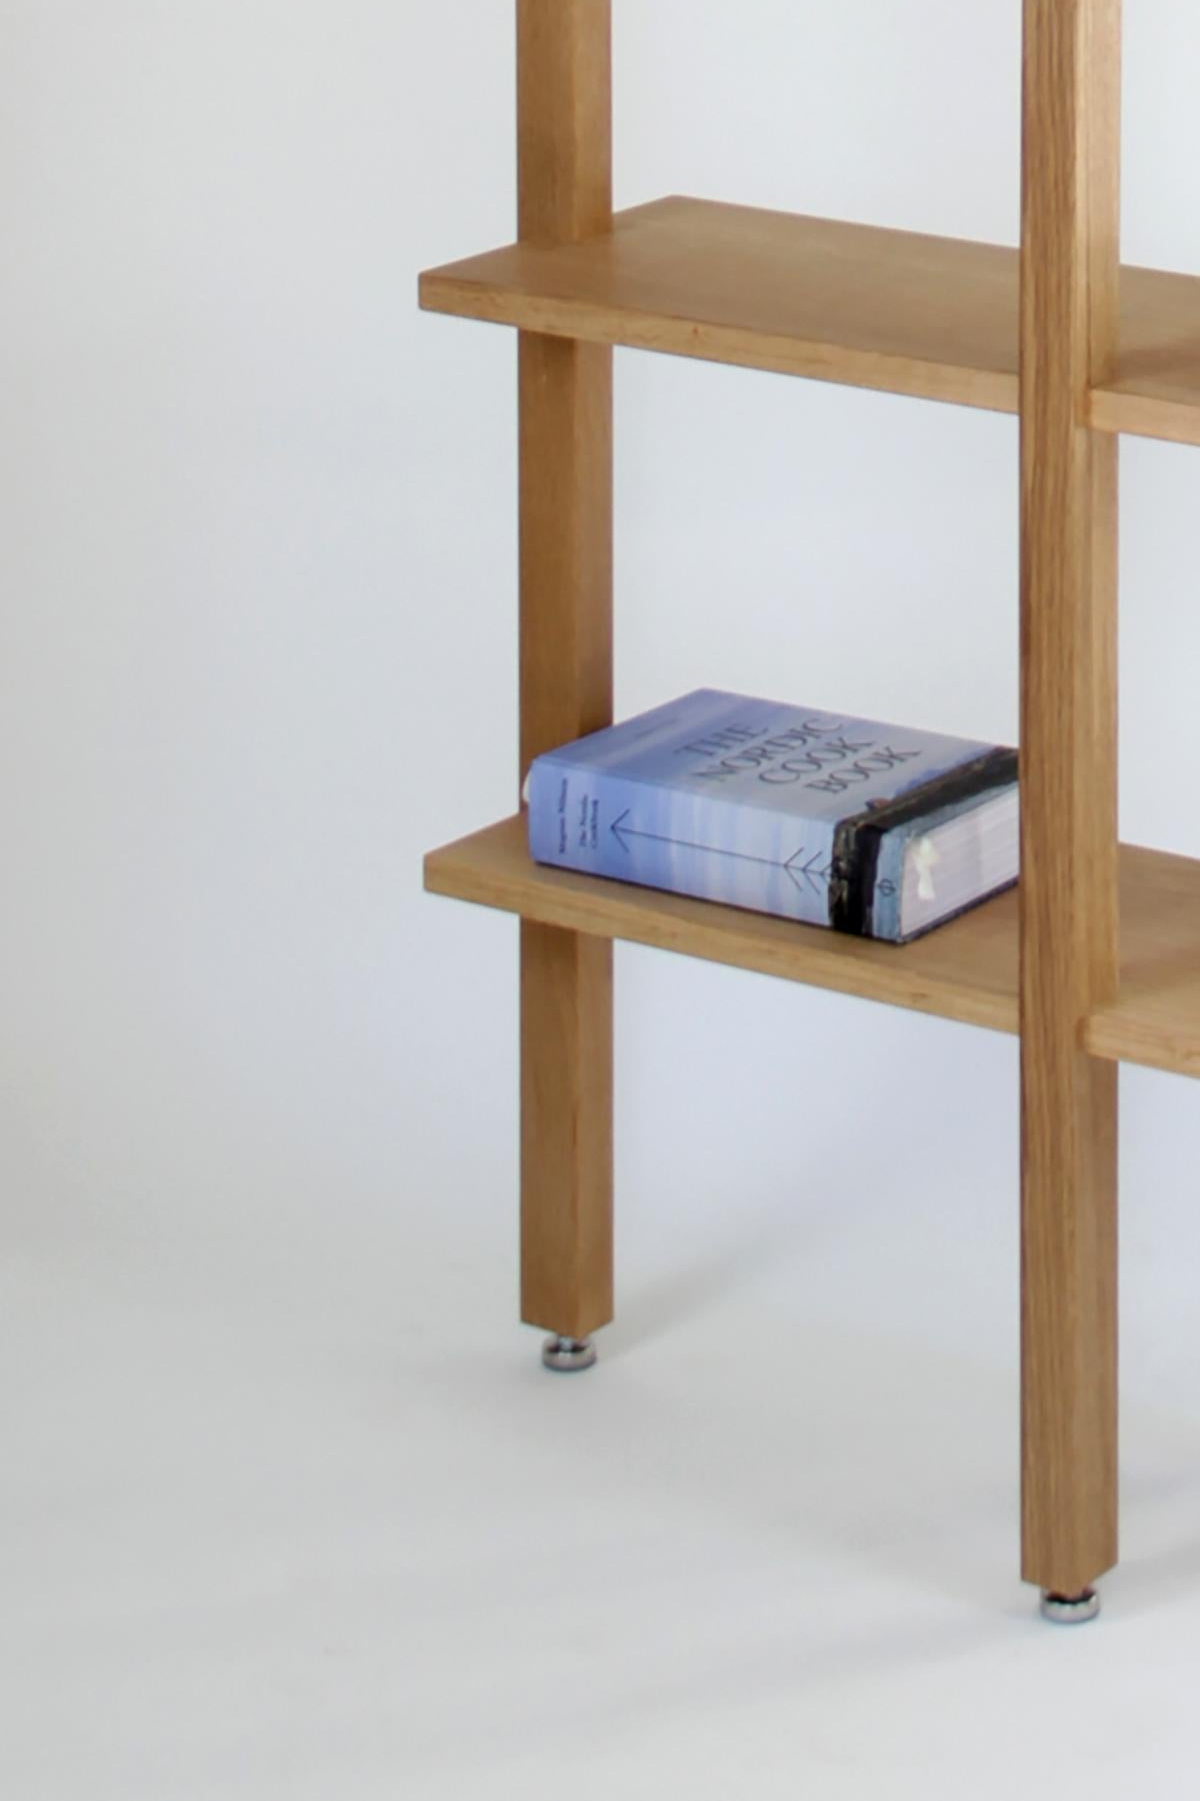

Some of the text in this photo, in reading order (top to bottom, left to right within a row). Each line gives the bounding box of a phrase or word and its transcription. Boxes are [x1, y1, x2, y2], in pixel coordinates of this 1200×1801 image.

[672, 721, 769, 757] THE
[691, 717, 843, 783] NORDIC
[758, 735, 876, 785] COOK
[804, 745, 922, 795] BOOK
